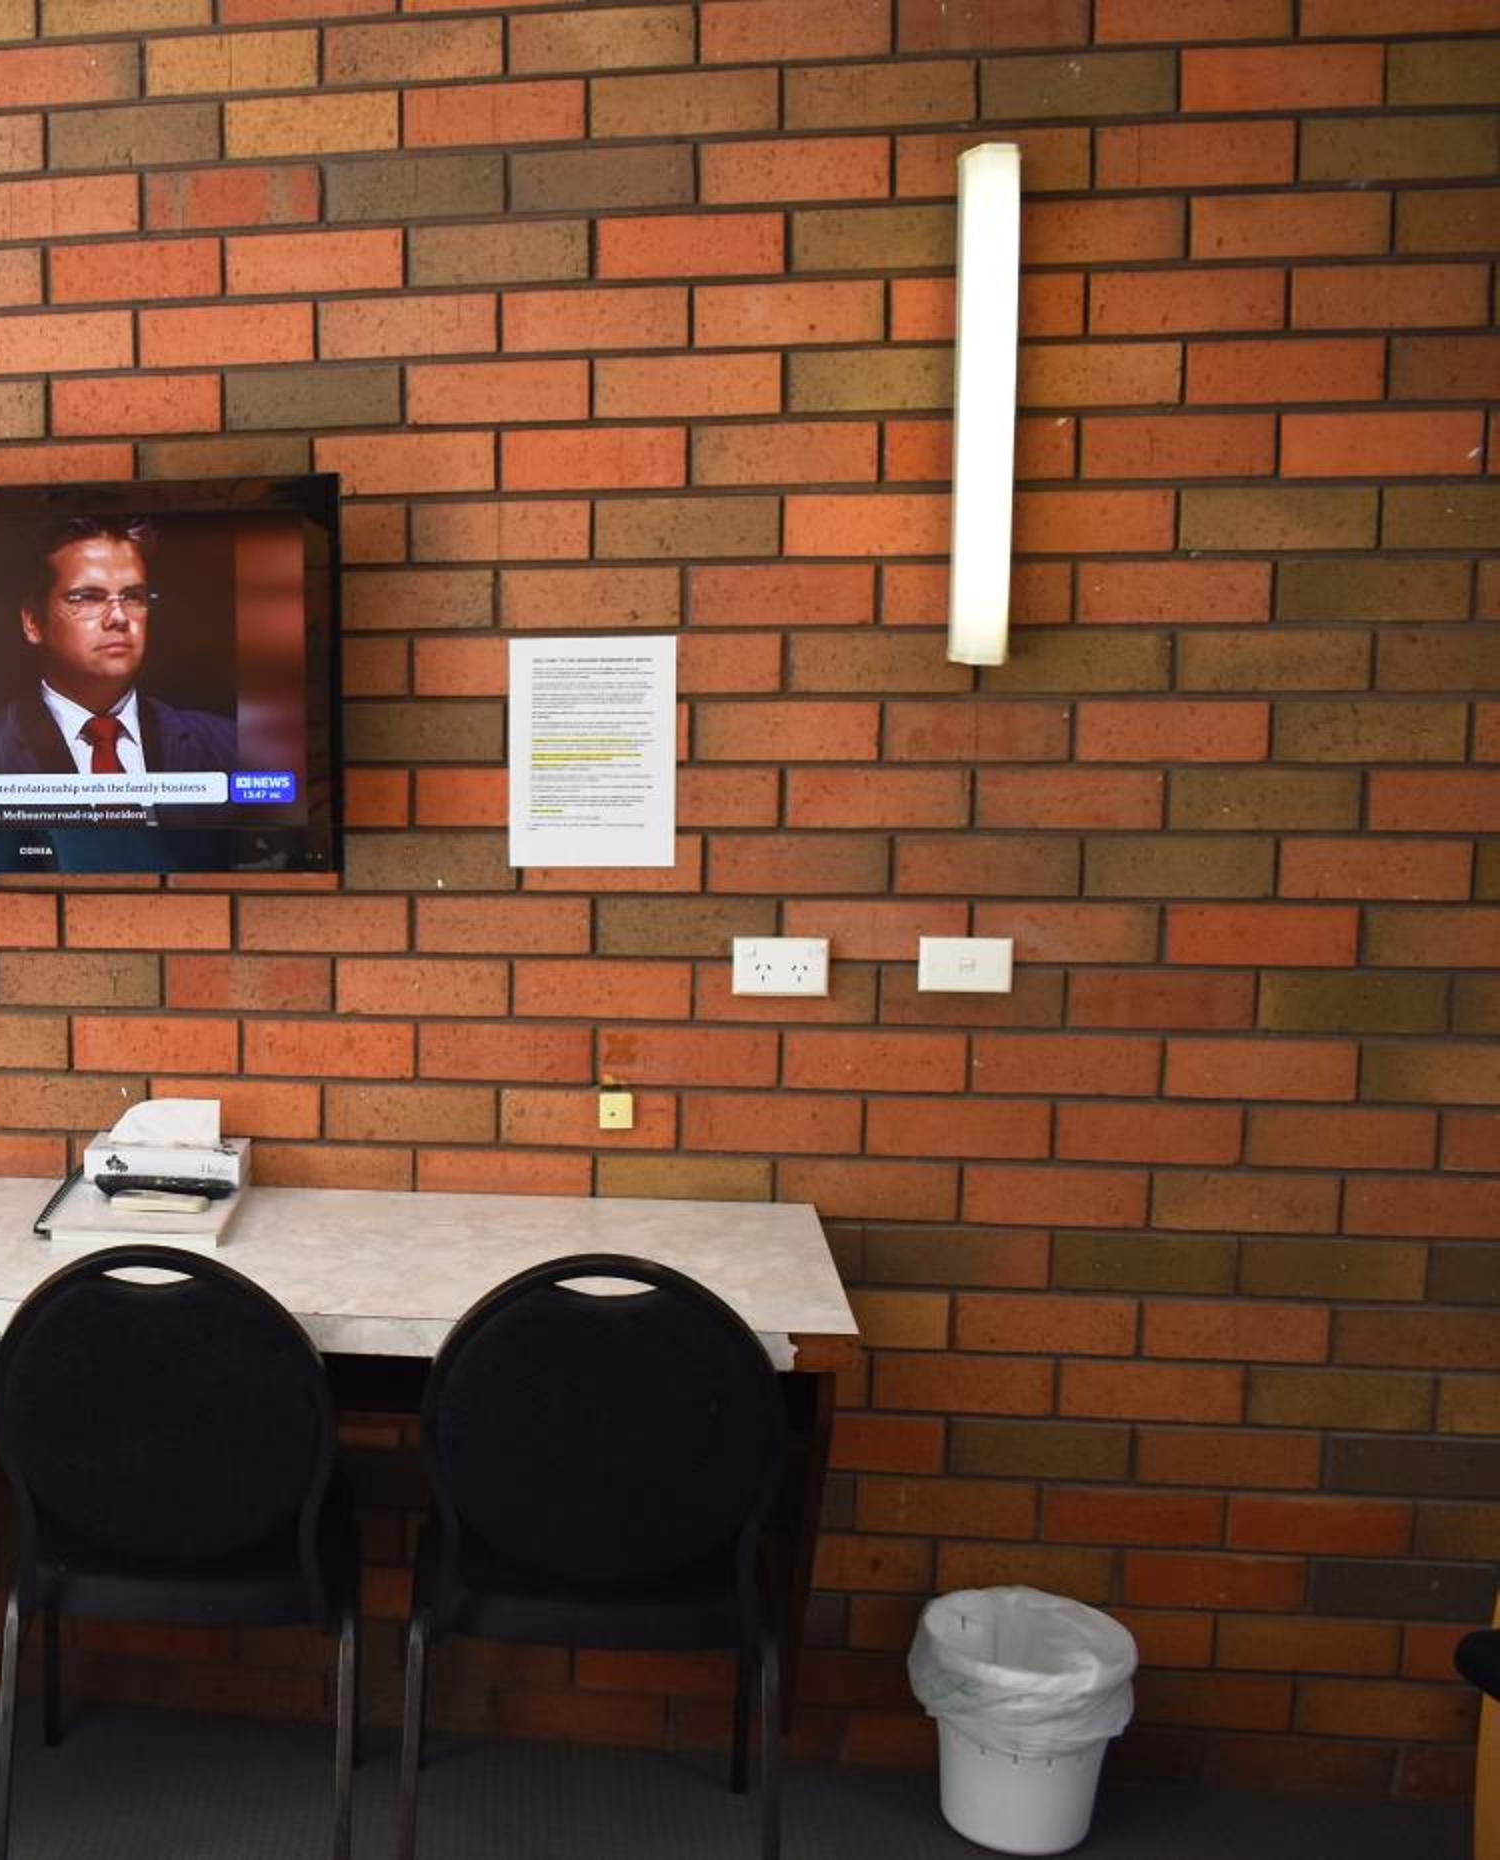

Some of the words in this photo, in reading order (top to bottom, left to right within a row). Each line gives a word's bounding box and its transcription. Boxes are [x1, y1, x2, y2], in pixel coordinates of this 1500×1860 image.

[17, 782, 80, 795] relationship
[81, 782, 105, 793] with
[107, 782, 124, 793] the
[125, 781, 158, 794] family
[161, 782, 207, 793] business
[253, 777, 290, 789] NEWS
[3, 810, 56, 820] Melbourne
[105, 810, 147, 820] incident
